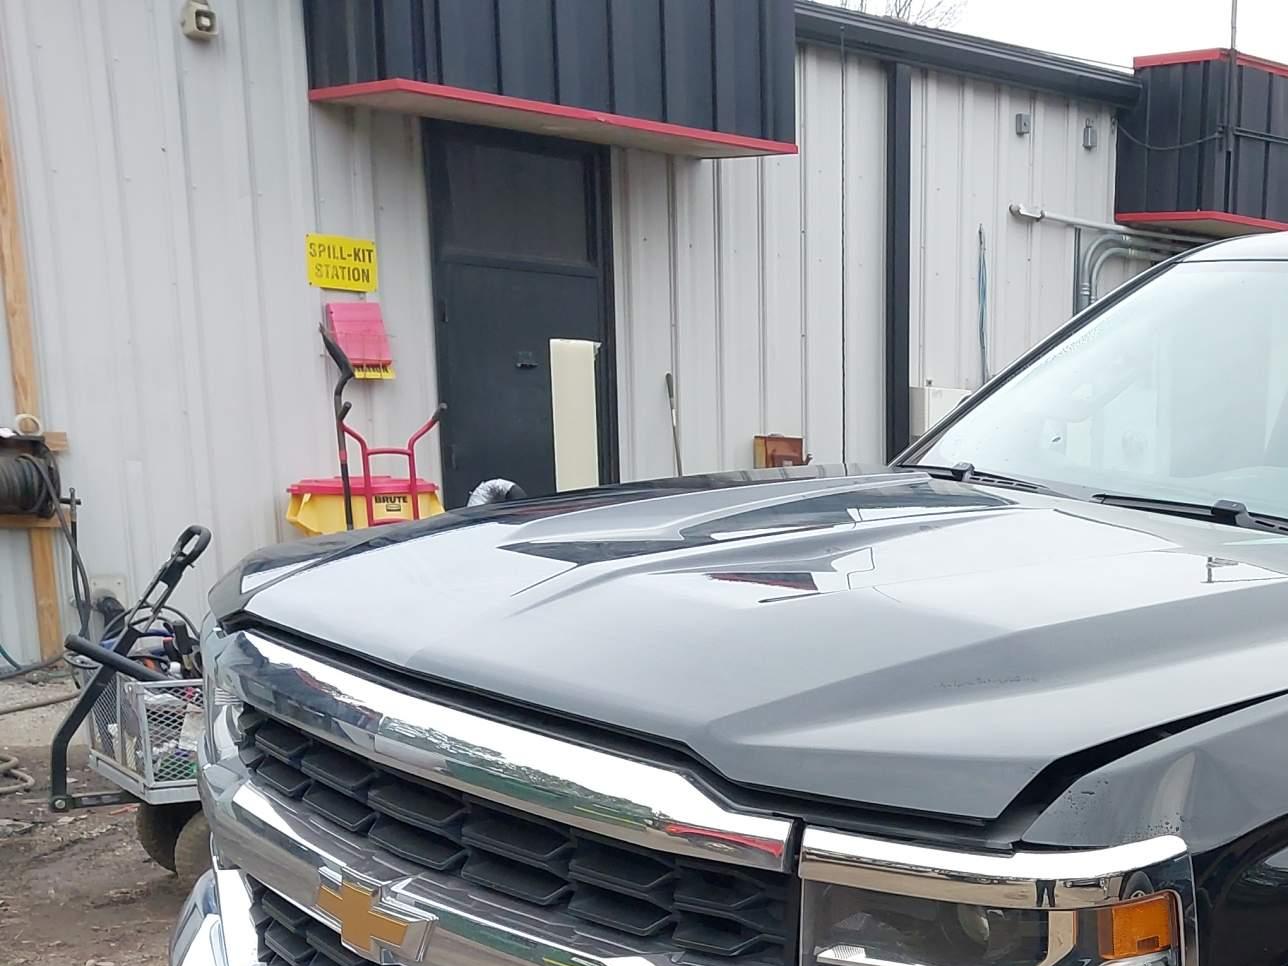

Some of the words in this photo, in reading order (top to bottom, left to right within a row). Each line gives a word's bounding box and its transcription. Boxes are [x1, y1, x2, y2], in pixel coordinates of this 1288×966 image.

[309, 242, 374, 264] SPILL-KIT
[315, 263, 370, 283] STATION
[375, 495, 408, 504] BRUTE
